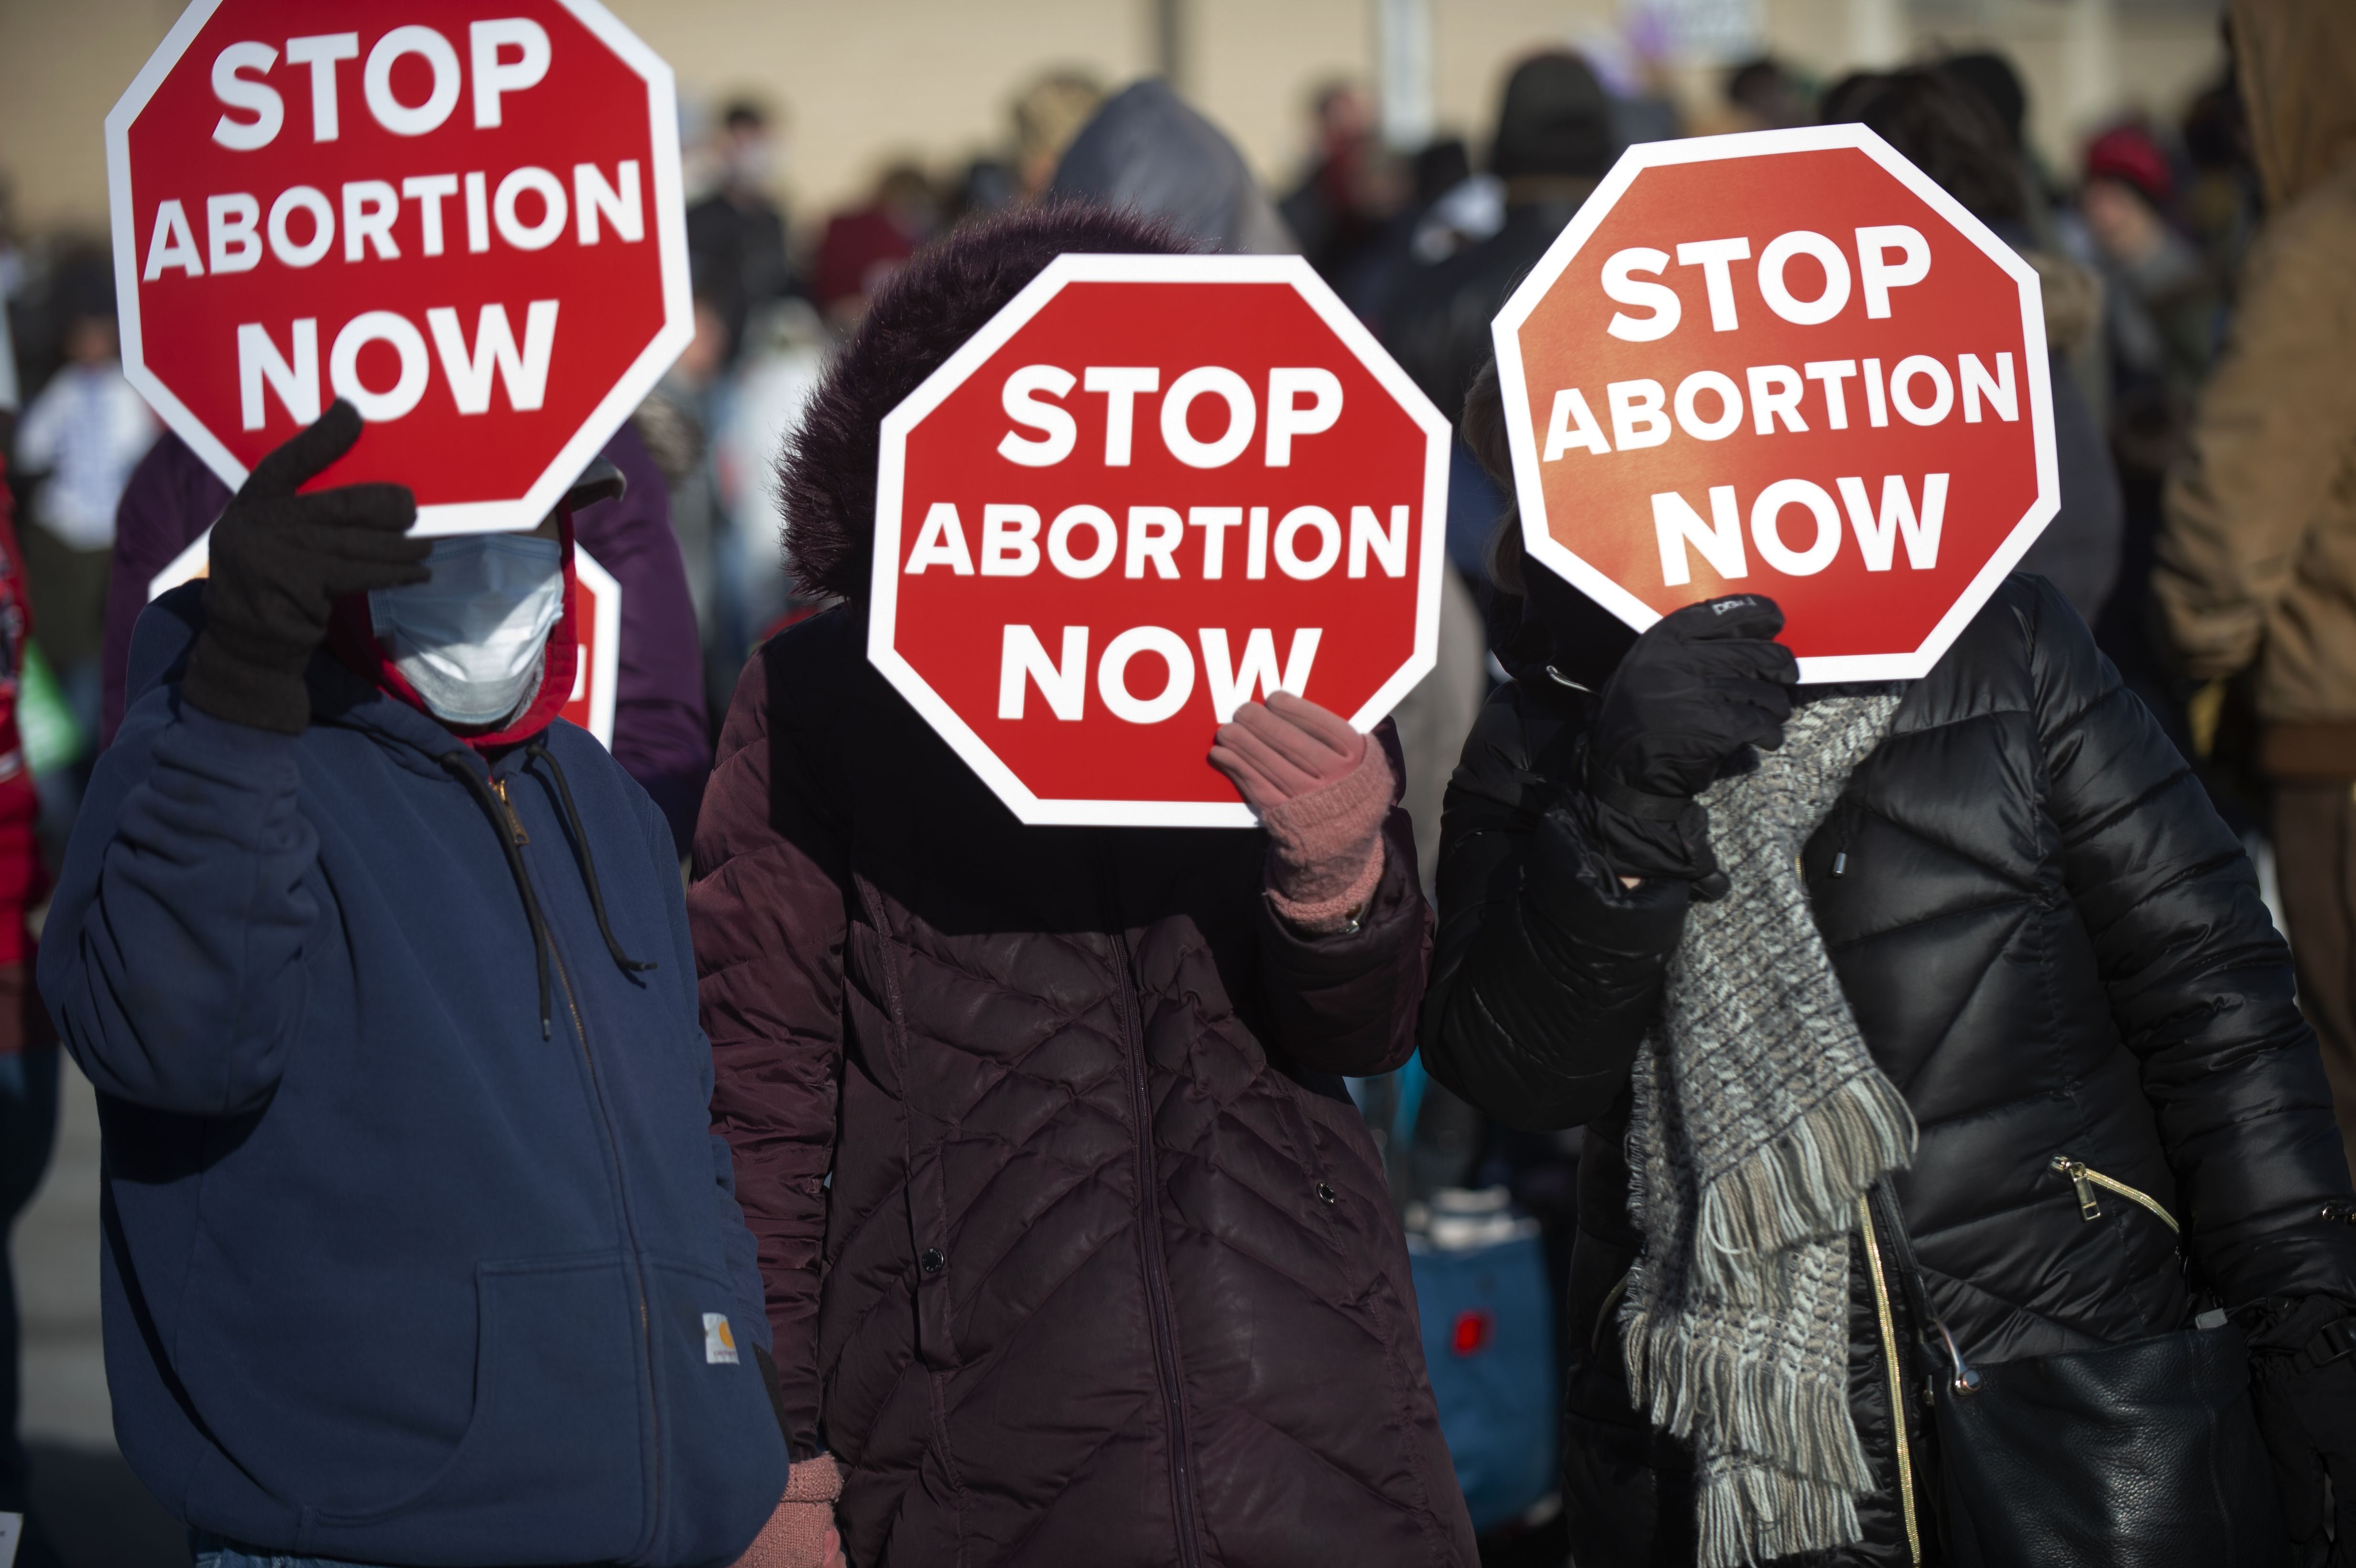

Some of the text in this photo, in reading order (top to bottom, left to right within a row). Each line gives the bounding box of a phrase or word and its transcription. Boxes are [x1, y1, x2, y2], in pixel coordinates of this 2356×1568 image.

[211, 18, 551, 151] STOP
[143, 160, 644, 281] ABORTION
[1600, 225, 1931, 343] STOP
[237, 300, 559, 431] NOW
[997, 364, 1343, 468] STOP
[1541, 352, 2019, 463] ABORTION
[904, 502, 1409, 580] ABORTION
[1650, 473, 1950, 587] NOW
[998, 624, 1323, 725] NOW
